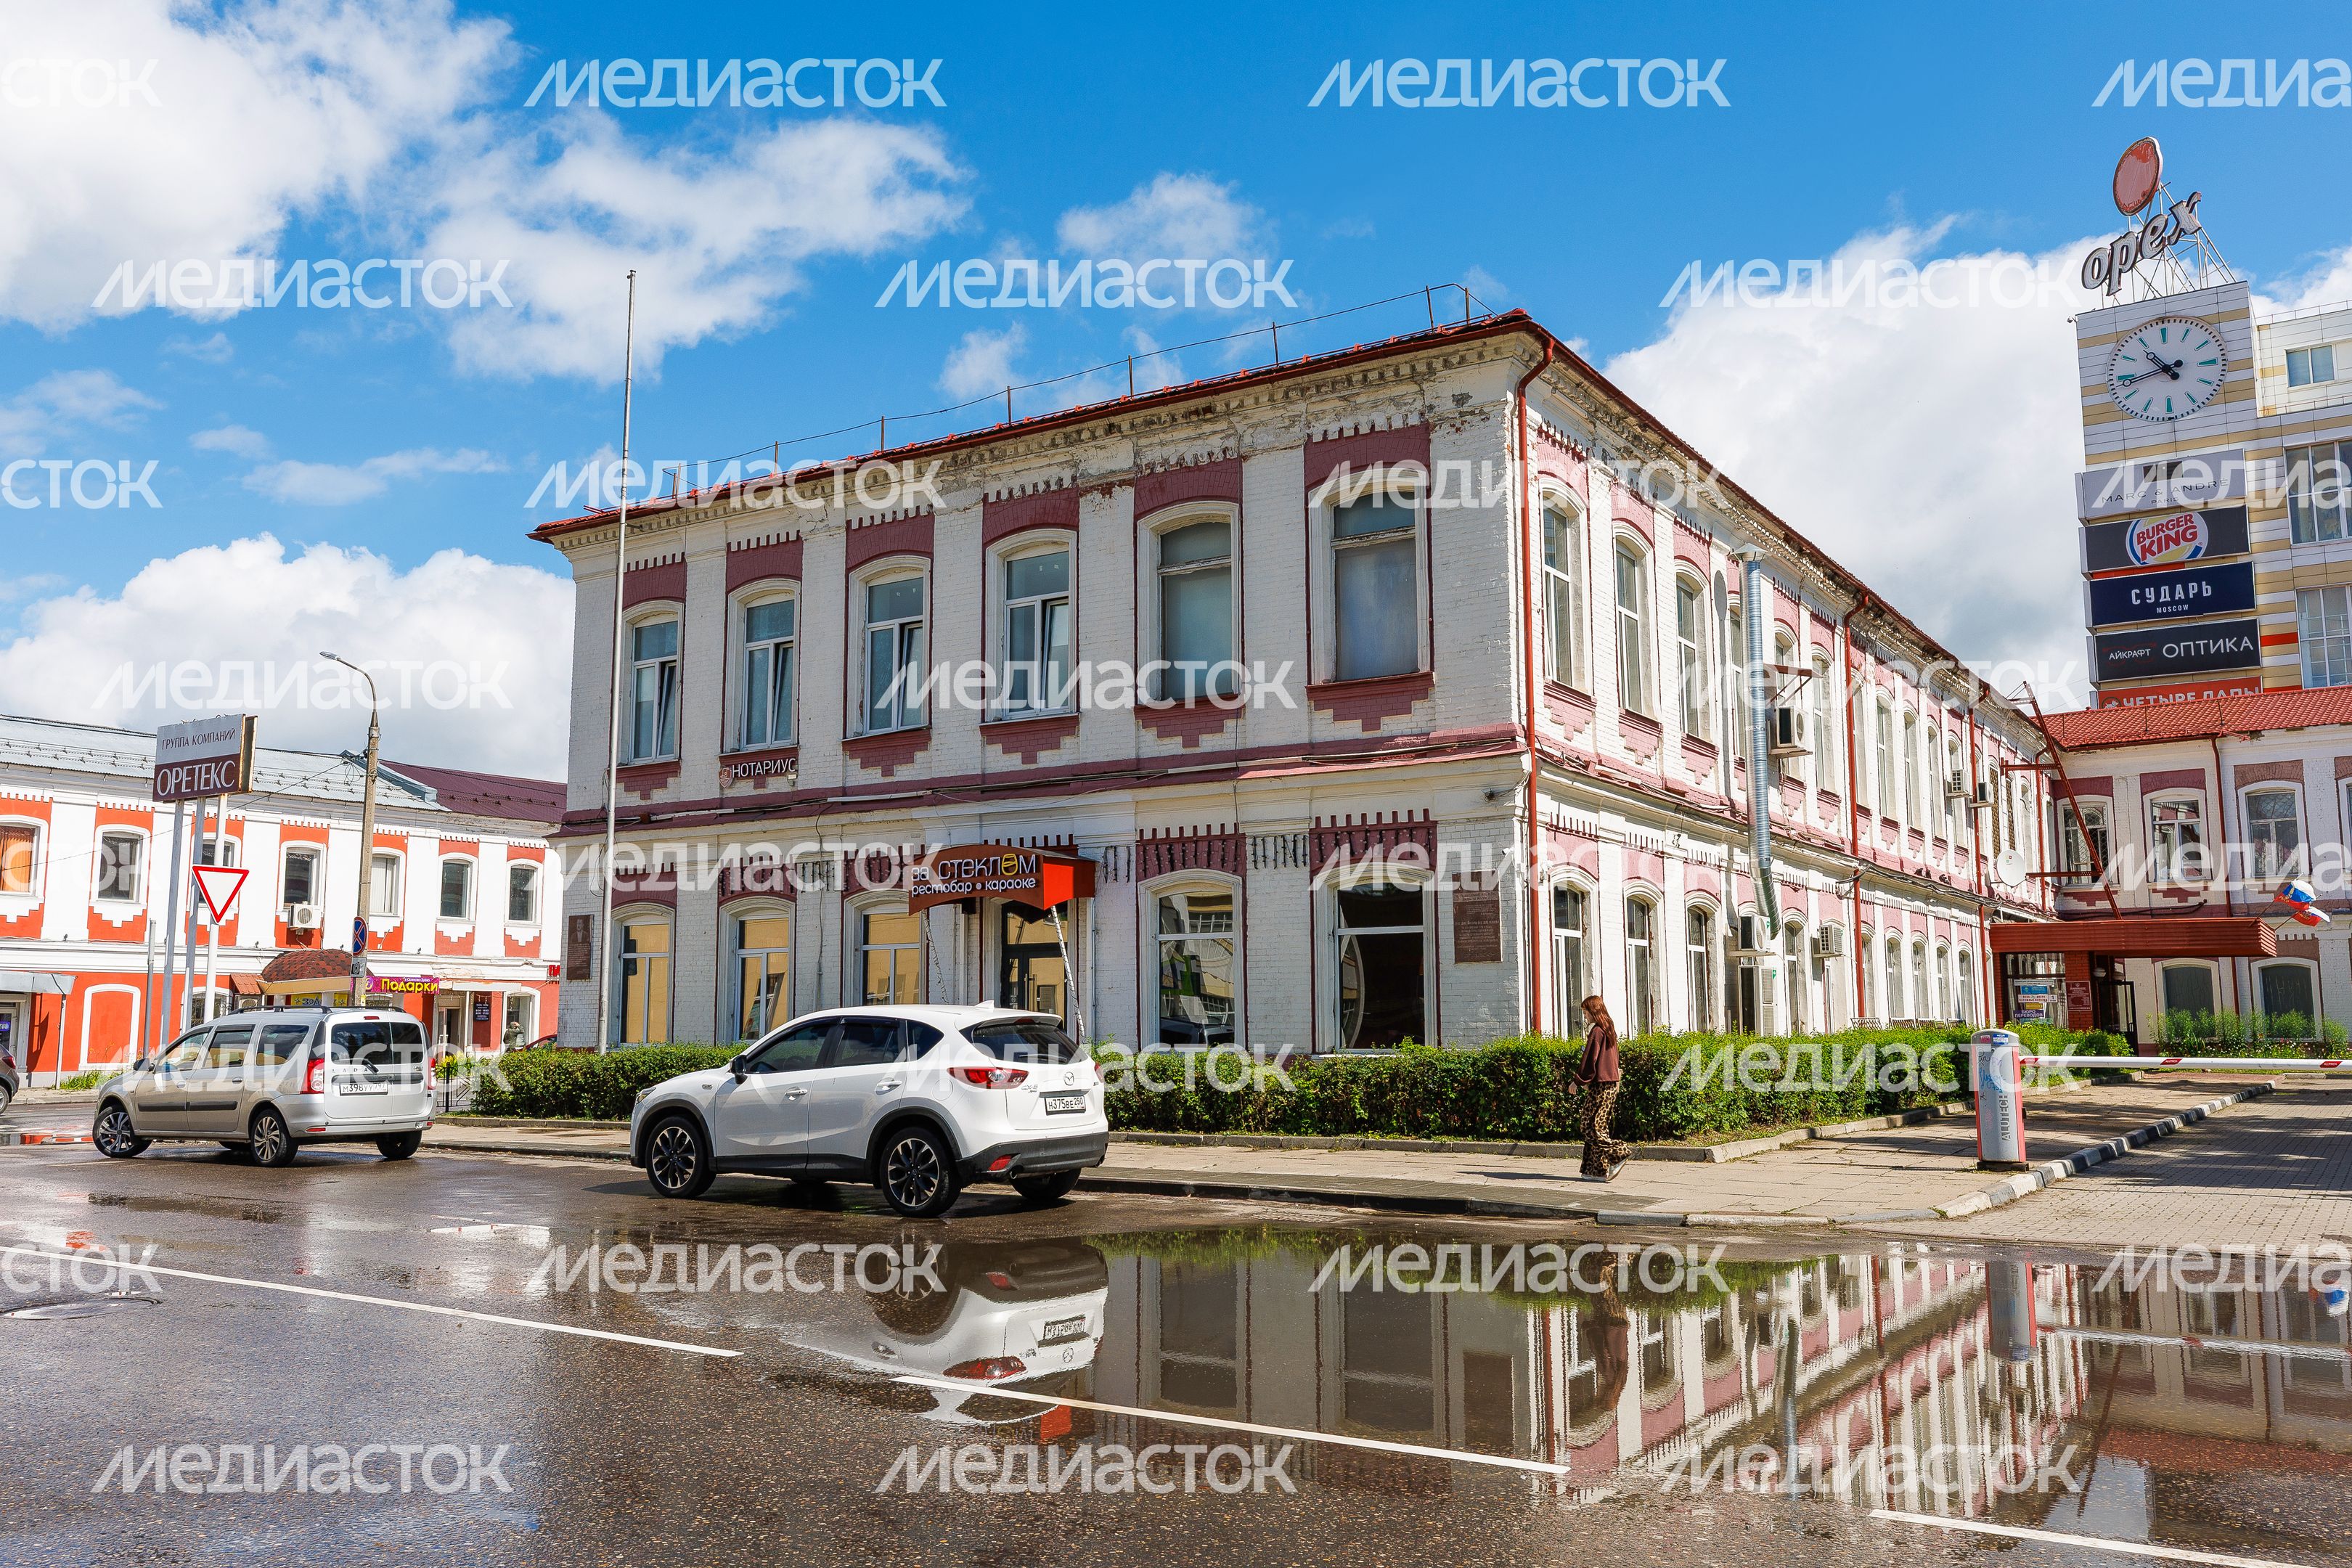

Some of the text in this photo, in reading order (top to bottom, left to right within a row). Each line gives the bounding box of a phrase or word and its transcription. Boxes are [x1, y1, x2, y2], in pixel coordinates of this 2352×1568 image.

[2102, 490, 2147, 504] MARC
[2171, 478, 2229, 494] ANDRÉ
[2136, 512, 2194, 545] BURGER
[2140, 525, 2198, 562] KING
[2131, 581, 2212, 605] СУДАРЬ
[2156, 604, 2189, 613] MOSCOW
[2109, 636, 2253, 661] АЙКРАФТ ОПТИКА
[162, 728, 236, 750] ГРУППА КОМПАНИЙ
[157, 760, 236, 796] ОРЕТЕКС
[732, 758, 796, 778] НОТАРИУС
[912, 877, 1036, 897] рестобар караоке
[381, 979, 438, 994] Подарки
